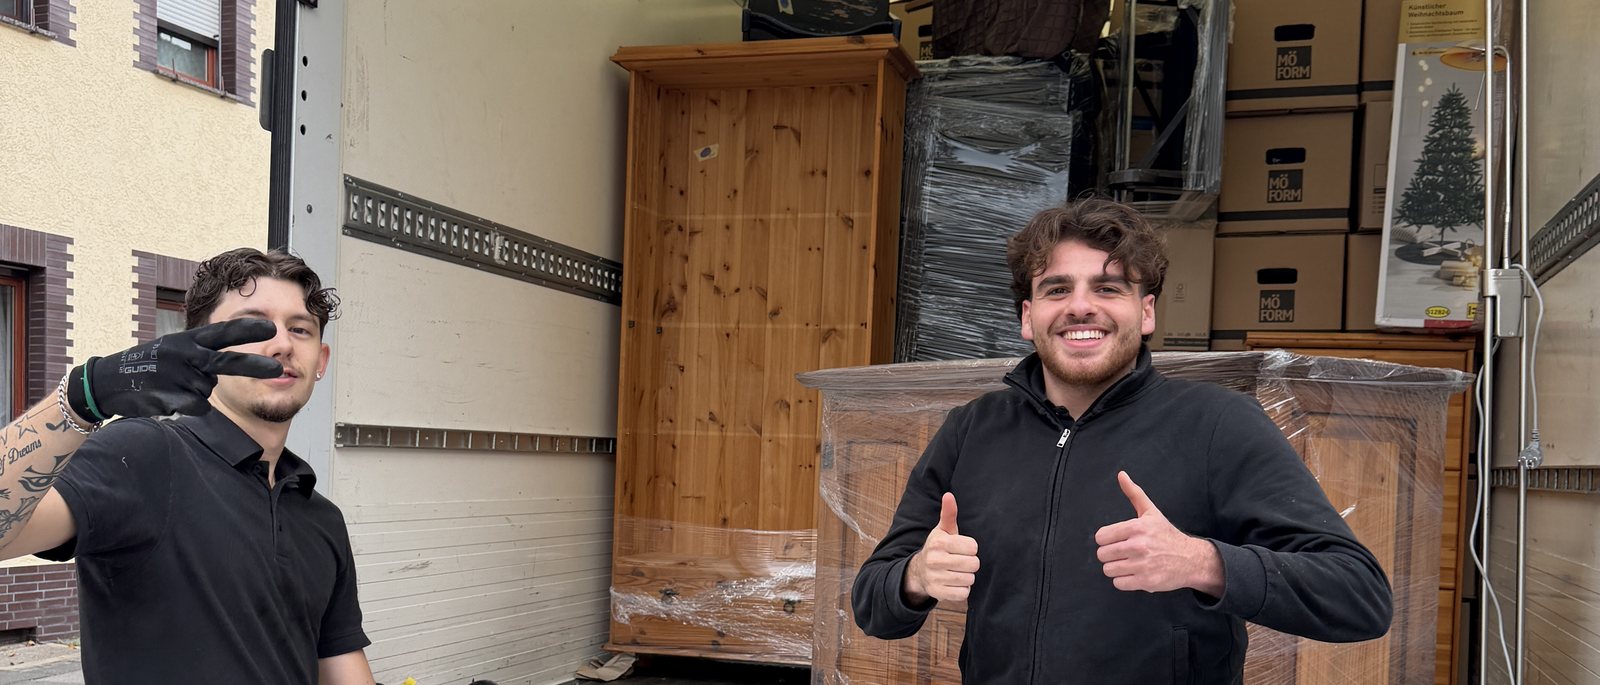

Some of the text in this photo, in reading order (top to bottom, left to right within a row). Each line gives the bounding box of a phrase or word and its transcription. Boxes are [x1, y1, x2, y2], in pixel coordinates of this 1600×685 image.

[1408, 10, 1464, 18] Weihnachtsbaum
[1277, 50, 1298, 66] MÖ
[1277, 65, 1311, 79] FORM
[1269, 173, 1289, 189] MÖ
[1268, 188, 1302, 202] FORM
[1260, 293, 1281, 309] MÖ
[1260, 308, 1293, 321] FORM
[124, 364, 157, 374] GUIDE
[8, 439, 42, 465] Dreams
